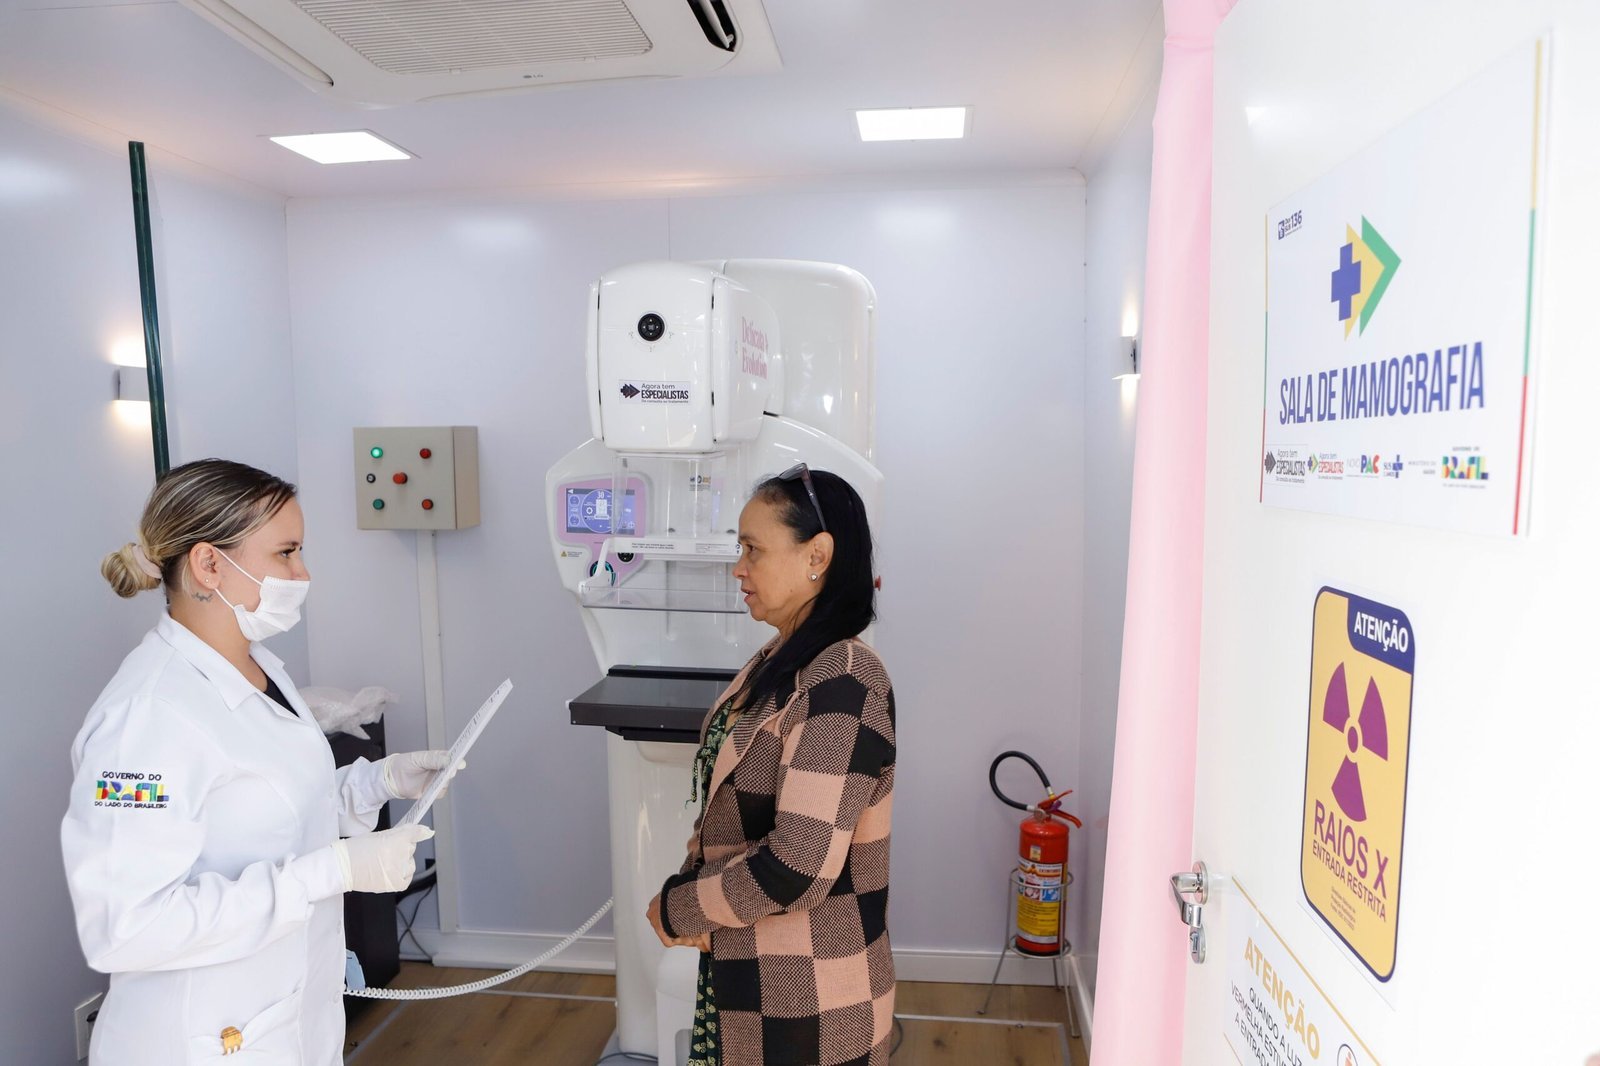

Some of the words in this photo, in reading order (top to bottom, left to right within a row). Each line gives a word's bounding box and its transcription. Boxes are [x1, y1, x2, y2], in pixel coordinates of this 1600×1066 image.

[1291, 210, 1302, 228] 136
[641, 383, 660, 391] Agora
[641, 390, 689, 400] ESPECIALISTAS
[1280, 374, 1313, 425] SALA
[1317, 369, 1338, 422] DE
[1341, 341, 1485, 421] MAMOGRAFIA
[1361, 454, 1380, 474] PAC
[1442, 456, 1489, 480] BRASIL
[1354, 611, 1409, 653] ATENÇÃO
[96, 780, 169, 802] BRASIL
[102, 771, 144, 780] GOVERNO
[148, 773, 162, 781] DO
[1313, 799, 1368, 879] RAIOS
[1373, 849, 1389, 899] X
[1312, 840, 1346, 883] ENTRADA
[1347, 872, 1386, 922] RESTRITA
[1231, 980, 1263, 1042] VERMELHA
[1244, 937, 1320, 1060] ATENÇÃO
[1250, 987, 1279, 1039] QUANDO
[1280, 1035, 1286, 1052] A
[1234, 1012, 1240, 1029] A
[1240, 1020, 1270, 1066] ENTRAD
